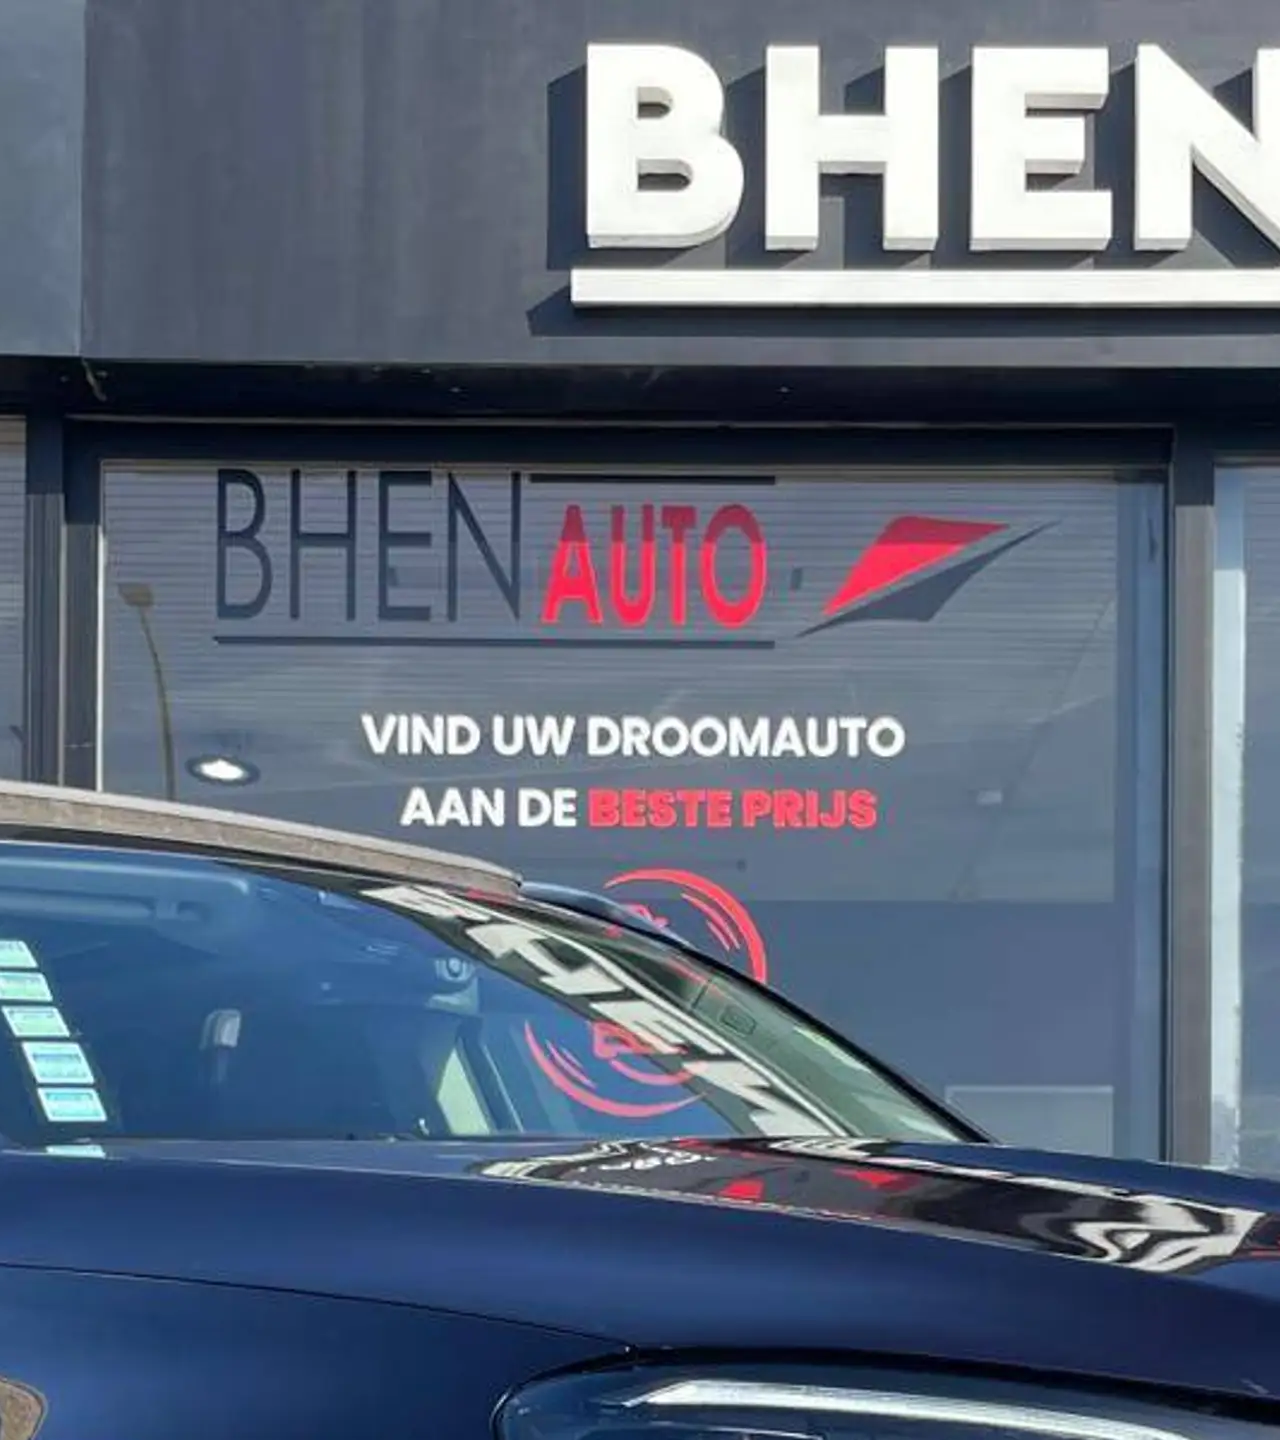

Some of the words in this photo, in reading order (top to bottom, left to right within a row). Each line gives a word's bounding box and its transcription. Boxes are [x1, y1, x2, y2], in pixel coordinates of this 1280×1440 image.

[215, 468, 520, 623] BHEN
[540, 503, 769, 629] AUTO
[361, 714, 481, 757] VIND
[492, 714, 577, 757] UW
[587, 714, 906, 758] DROOMAUTO
[400, 788, 508, 828] AAN
[517, 788, 577, 828] DE
[588, 788, 733, 829] BESTE
[742, 788, 879, 830] PRIJS
